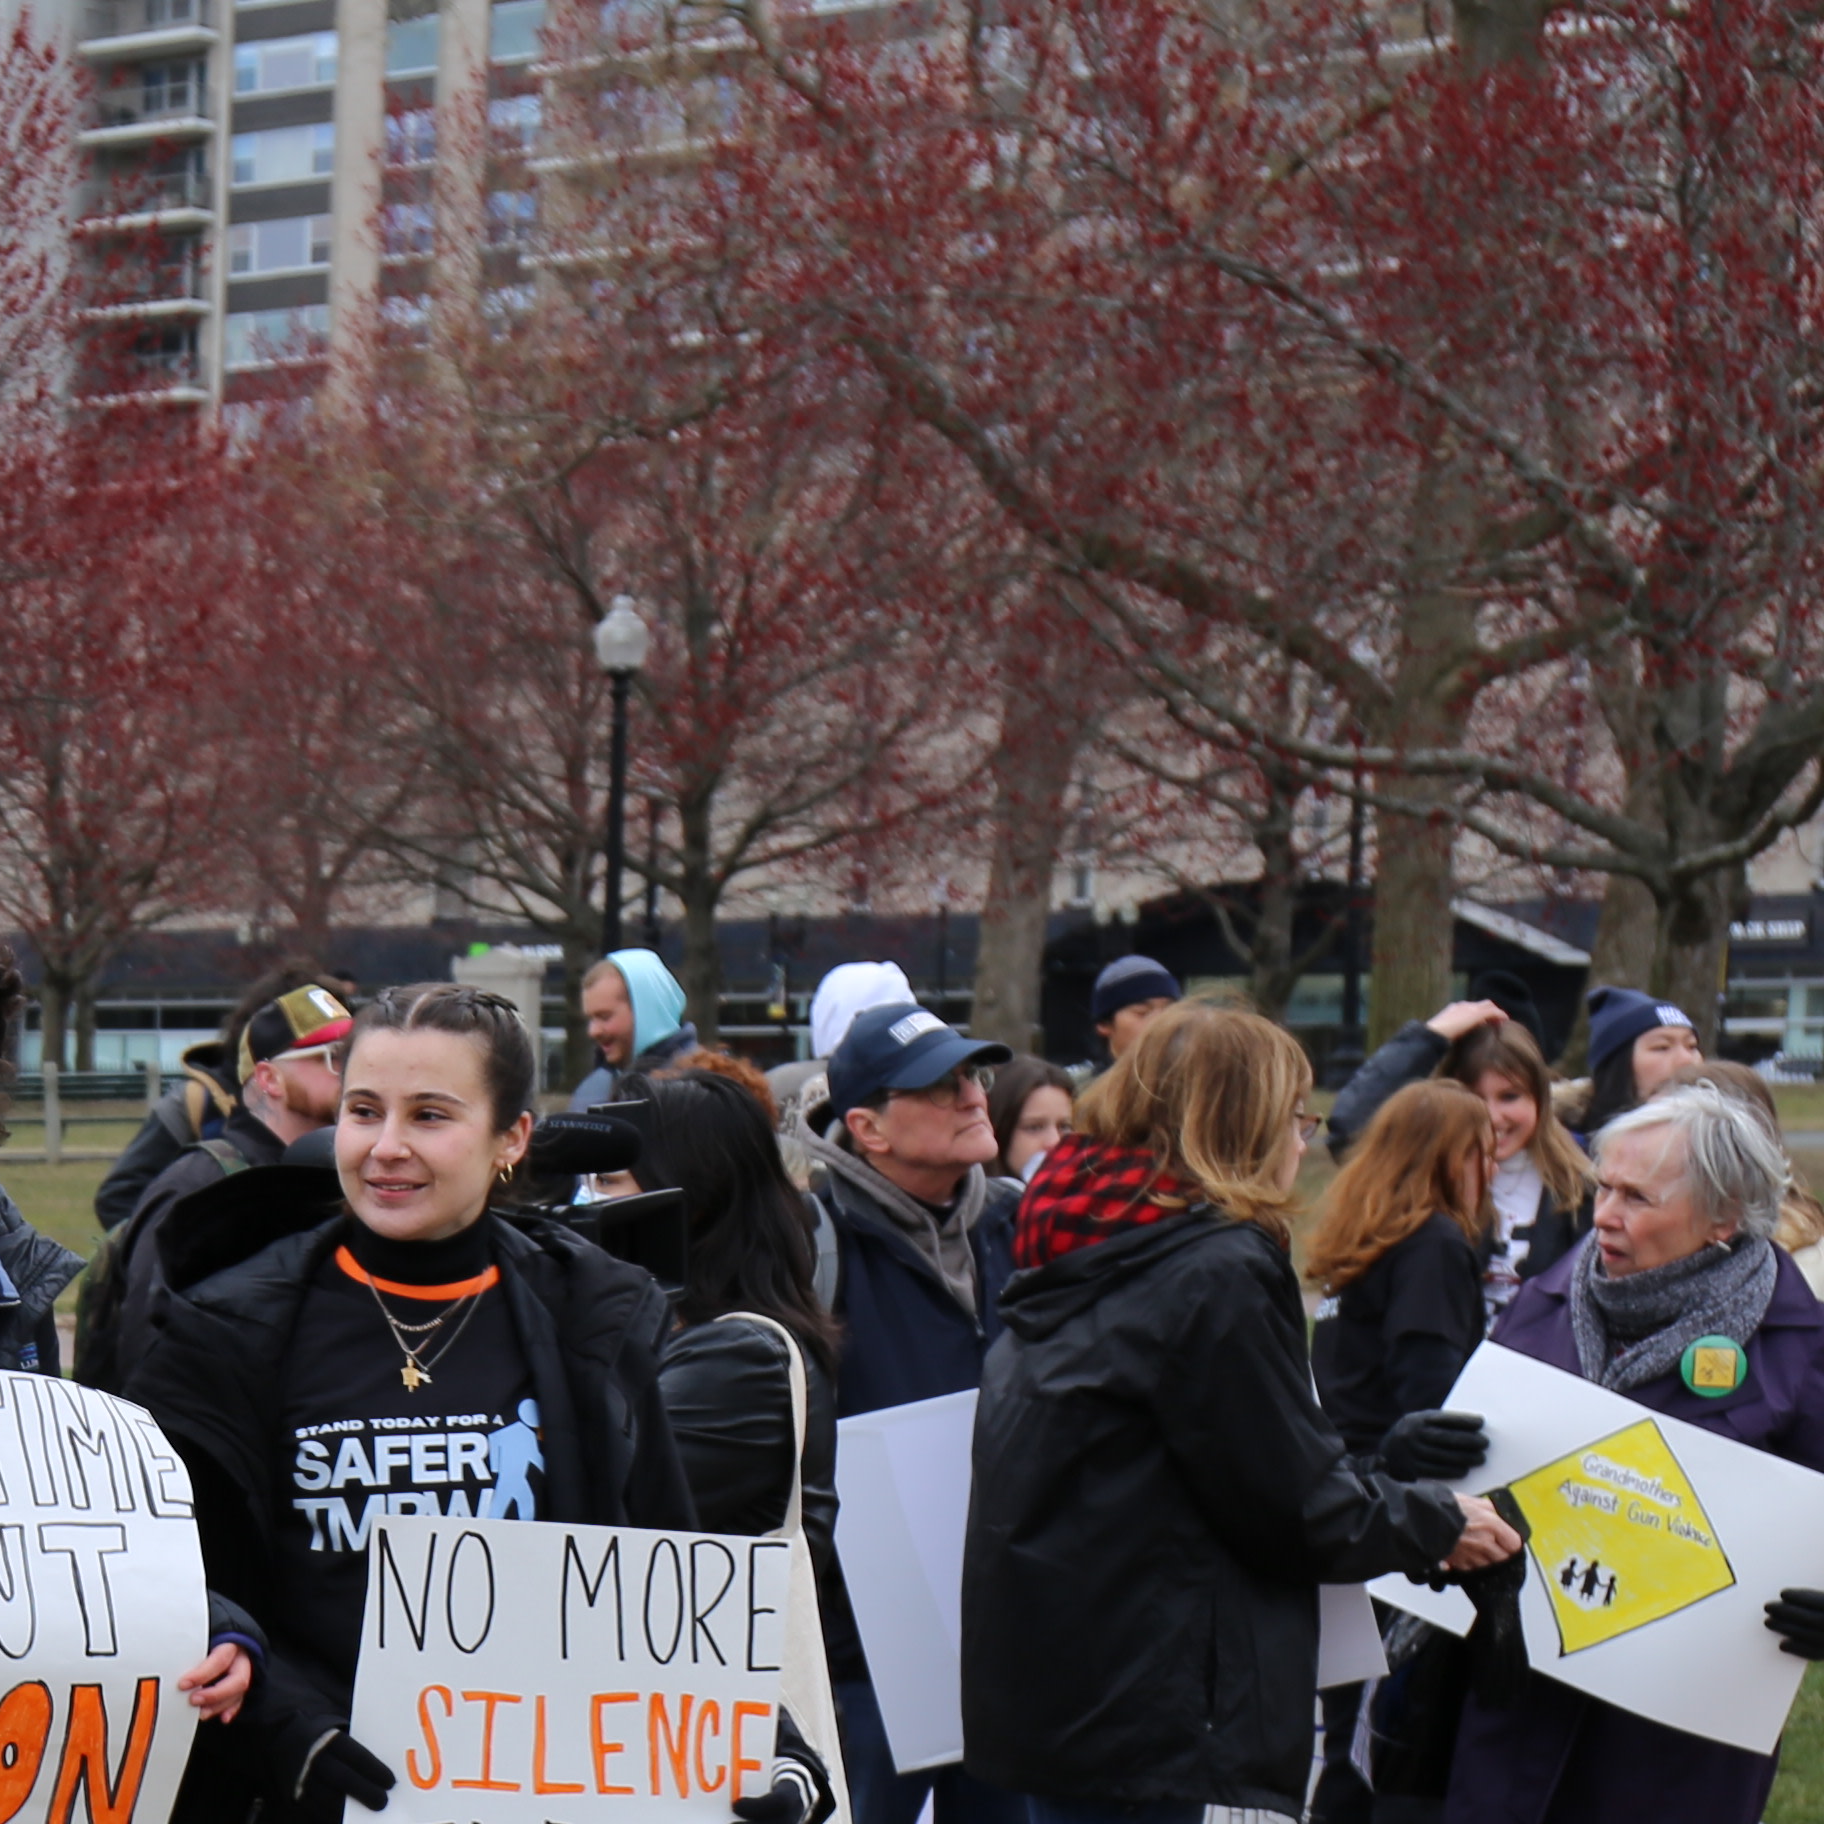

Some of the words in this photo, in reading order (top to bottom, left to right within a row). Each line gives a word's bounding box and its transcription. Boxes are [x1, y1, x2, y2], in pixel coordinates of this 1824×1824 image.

[295, 1417, 365, 1439] STAND
[369, 1415, 440, 1431] TODAY
[446, 1413, 488, 1428] FOR
[293, 1431, 492, 1491] SAFER
[1583, 1452, 1682, 1507] Grandmothers
[1558, 1478, 1620, 1513] Against
[1627, 1501, 1660, 1529] Gun
[376, 1526, 496, 1654] NO
[560, 1534, 790, 1672] MORE
[405, 1683, 772, 1800] SILENCE
